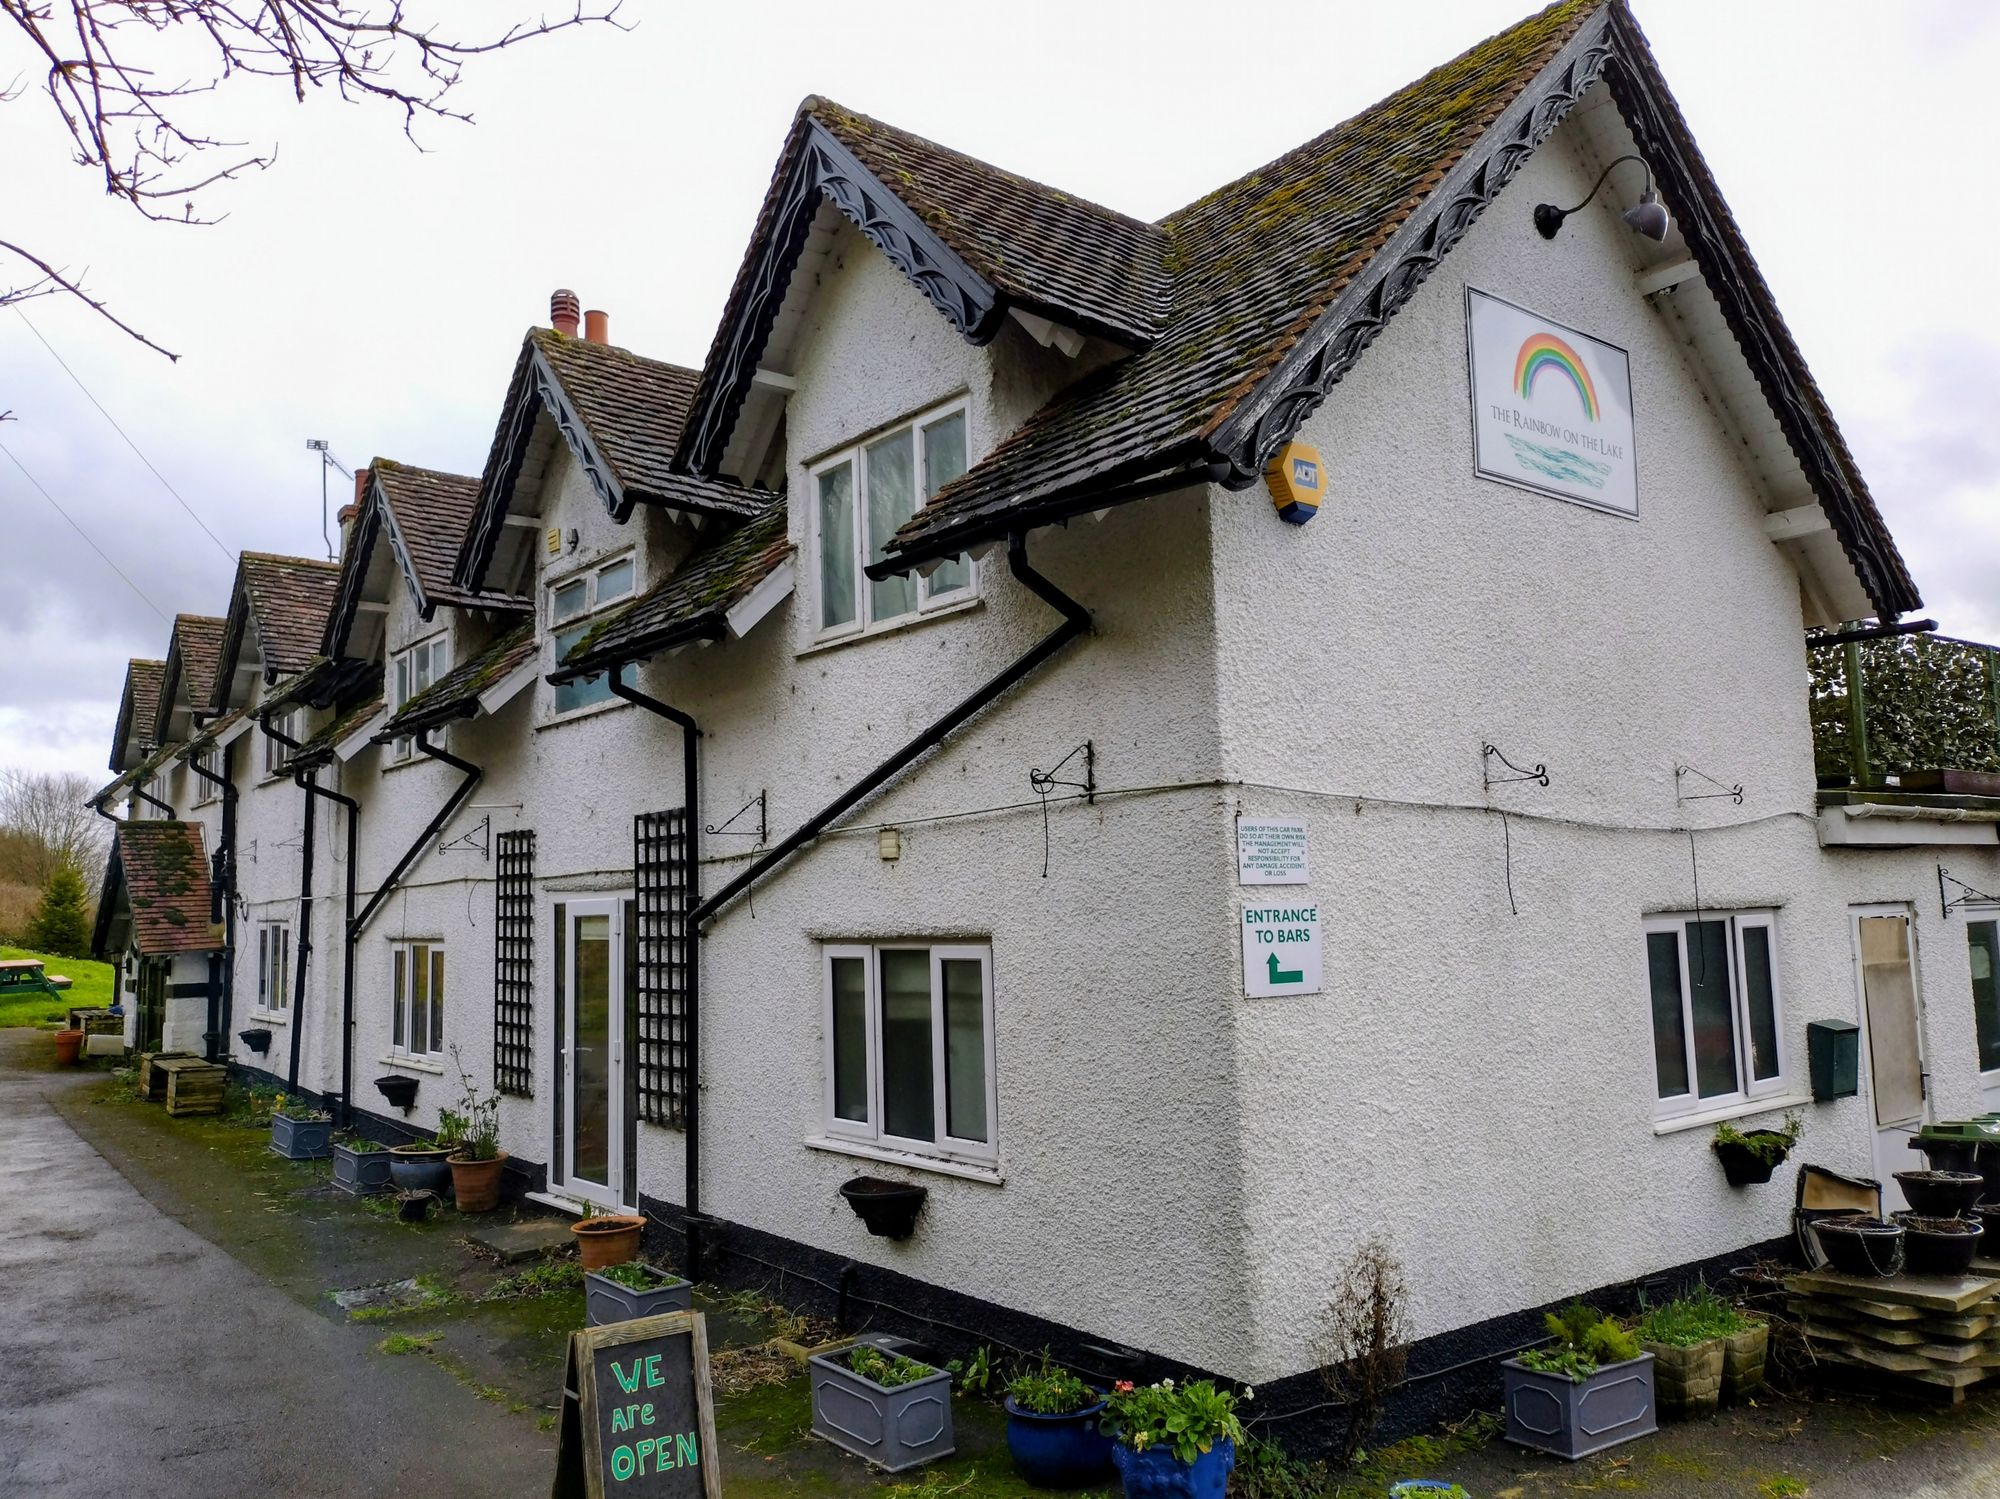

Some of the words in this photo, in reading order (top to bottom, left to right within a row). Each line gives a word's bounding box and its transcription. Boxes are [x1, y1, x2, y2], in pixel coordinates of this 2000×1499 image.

[1490, 405, 1511, 424] THE
[1564, 429, 1579, 445] ON
[1581, 434, 1598, 451] THE
[1246, 908, 1317, 923] ENTRANCE
[1256, 930, 1274, 943] TO
[1278, 929, 1310, 943] BARS
[610, 1354, 666, 1394] WE
[611, 1431, 698, 1481] OPEN
